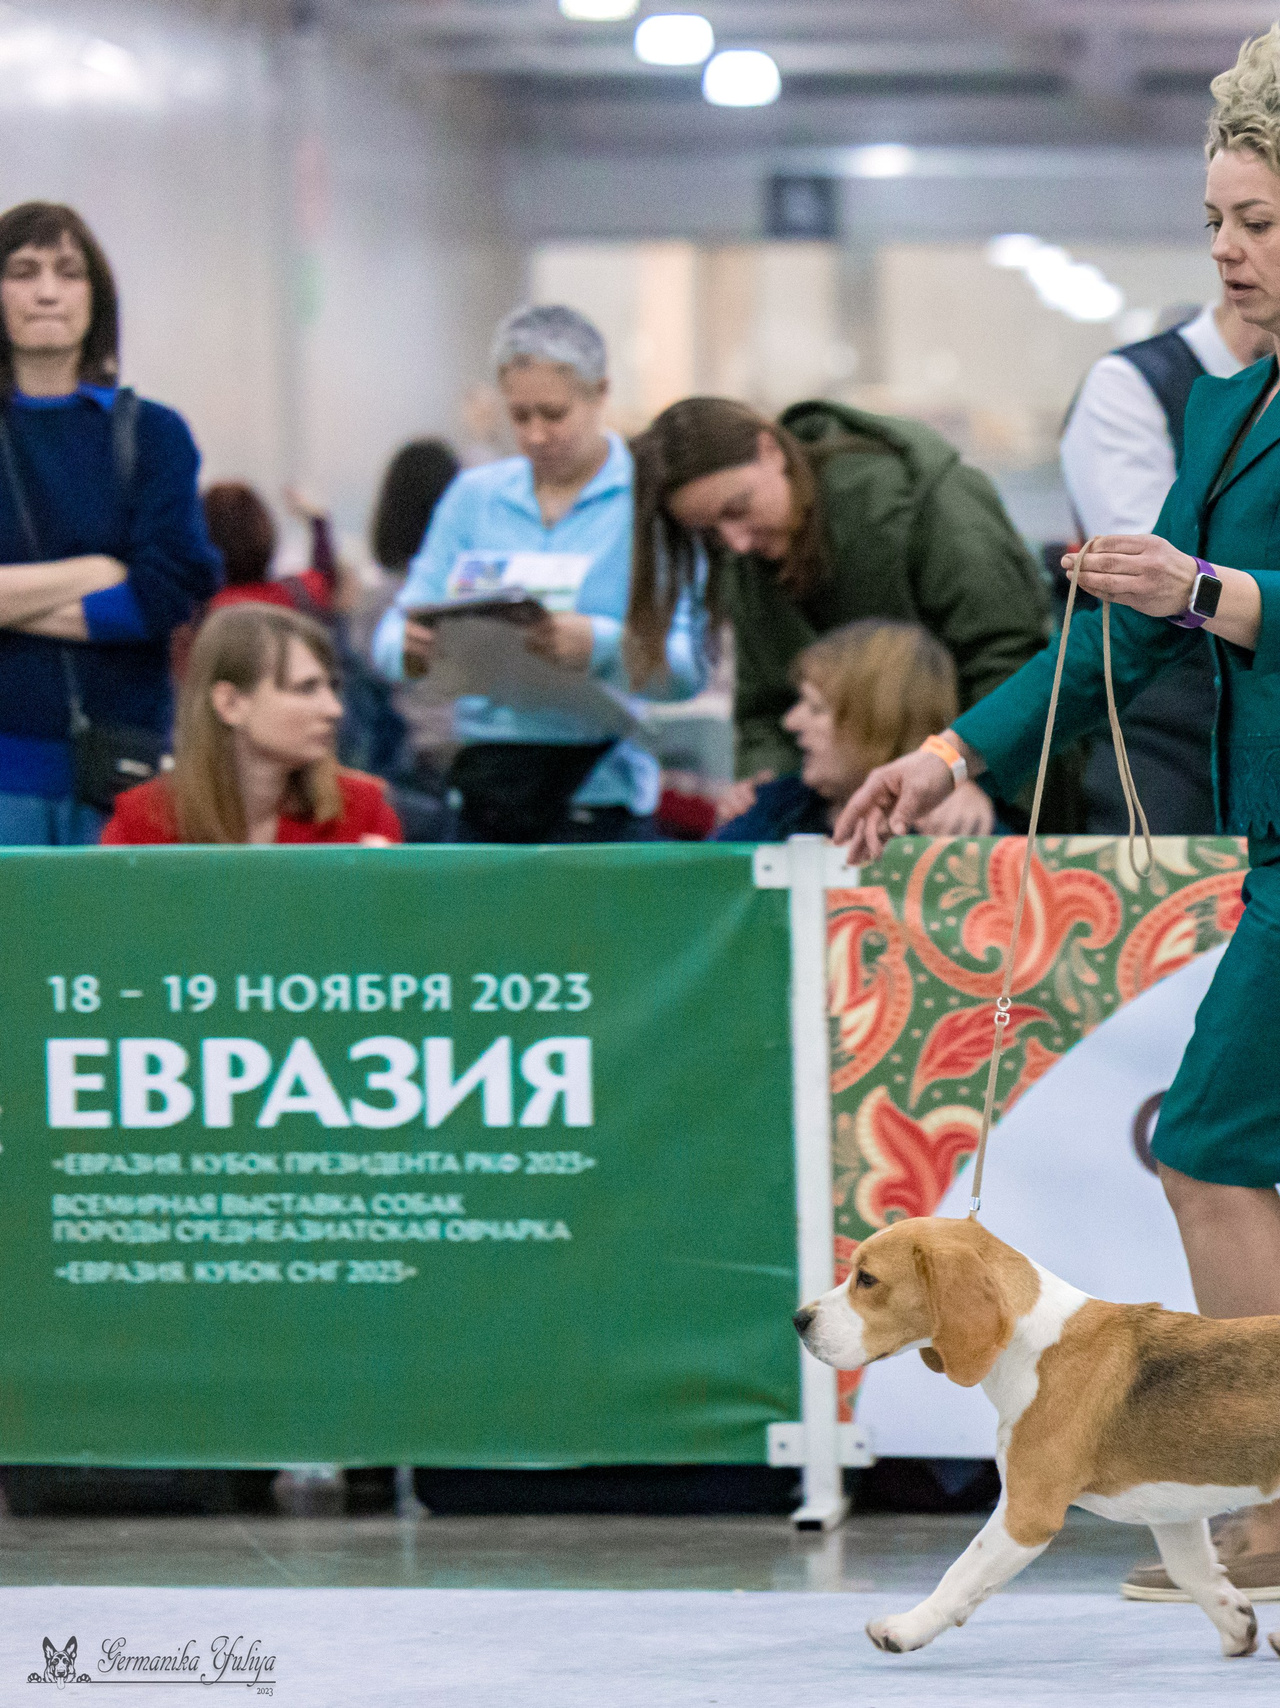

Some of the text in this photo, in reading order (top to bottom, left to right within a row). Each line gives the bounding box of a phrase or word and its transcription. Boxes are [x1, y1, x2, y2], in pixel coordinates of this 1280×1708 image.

[46, 974, 102, 1013] 18
[163, 974, 218, 1013] 19
[235, 973, 453, 1013] НОЯБРЯ
[470, 973, 594, 1013] 2023
[45, 1035, 595, 1130] ЕВРАЗИЯ
